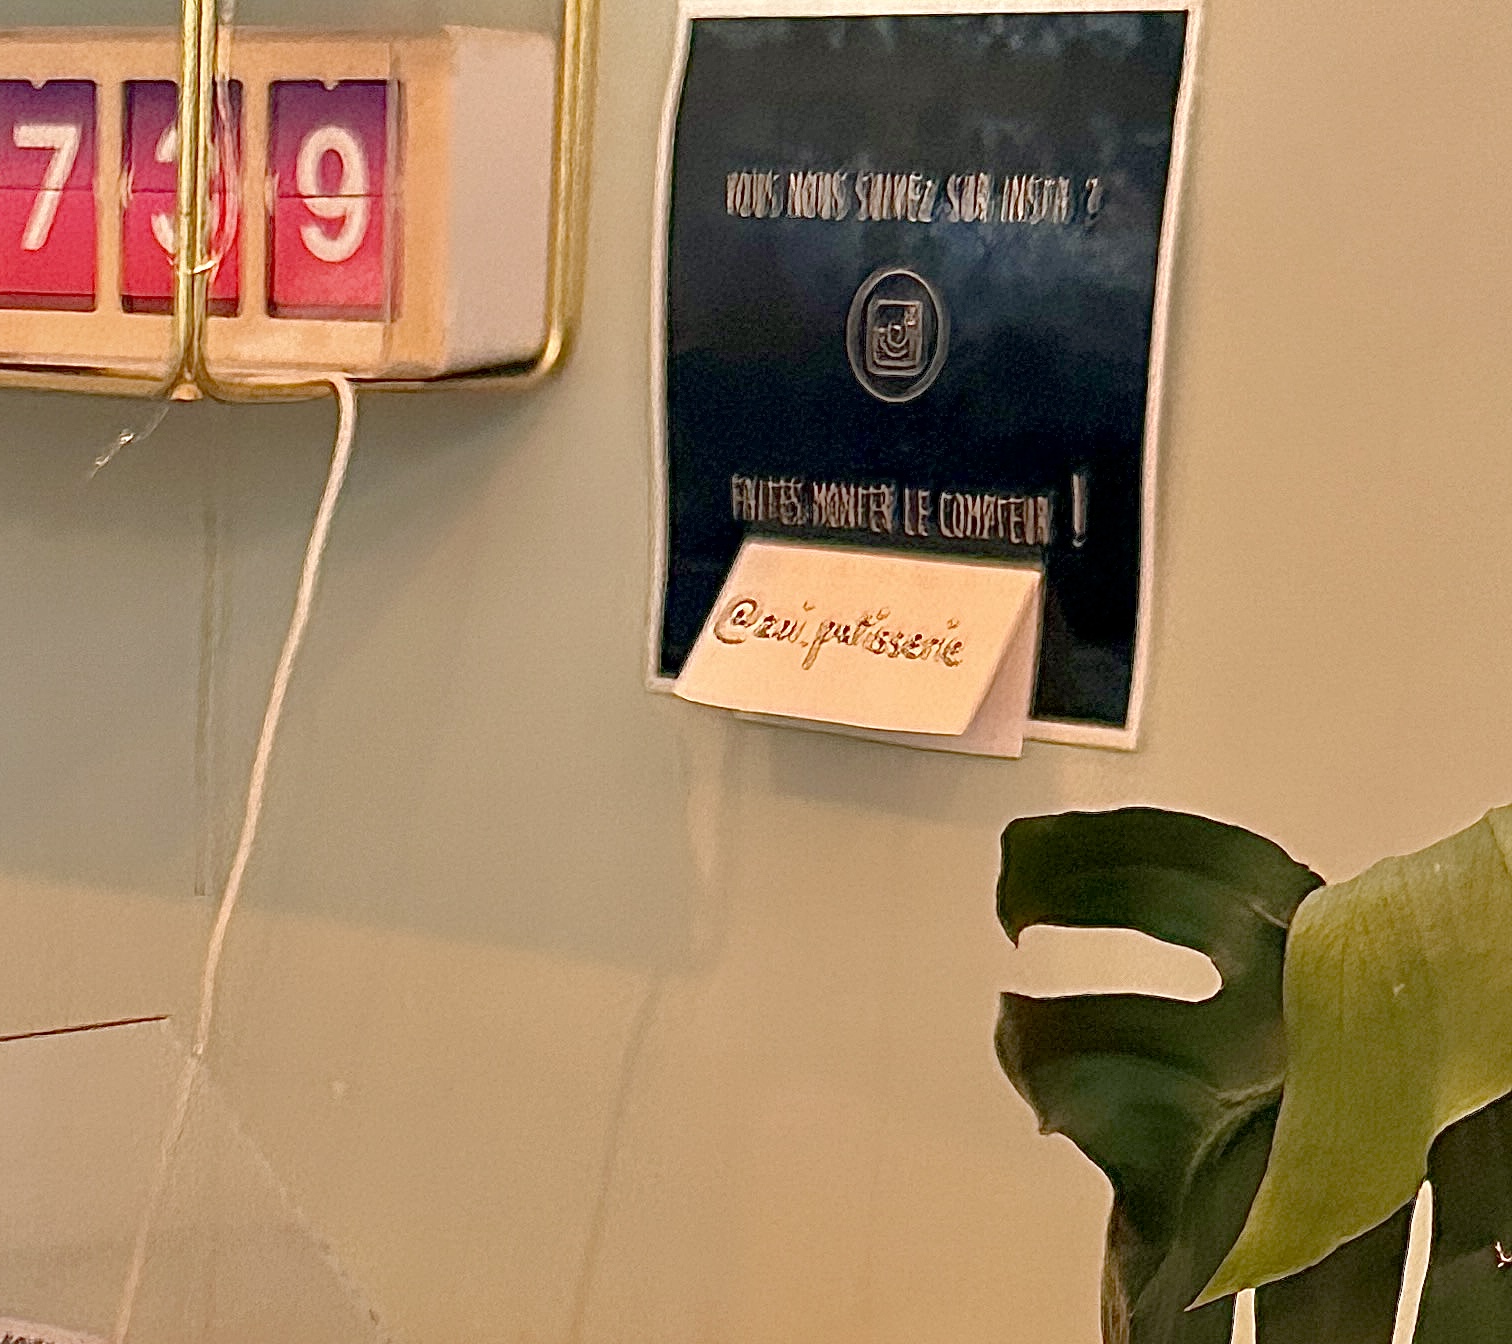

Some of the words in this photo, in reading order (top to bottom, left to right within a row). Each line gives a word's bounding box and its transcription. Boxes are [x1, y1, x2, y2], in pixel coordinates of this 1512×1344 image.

[726, 169, 782, 219] VOUS
[788, 169, 848, 221] NOUS
[854, 170, 937, 222] SUIVEZ
[945, 171, 990, 223] SUR
[1000, 174, 1072, 224] INSTA
[731, 473, 805, 526] FAITES
[812, 480, 898, 534] MONTER
[903, 486, 930, 537] LE
[937, 490, 1053, 546] COMPTEUR
[1071, 472, 1087, 548] !
